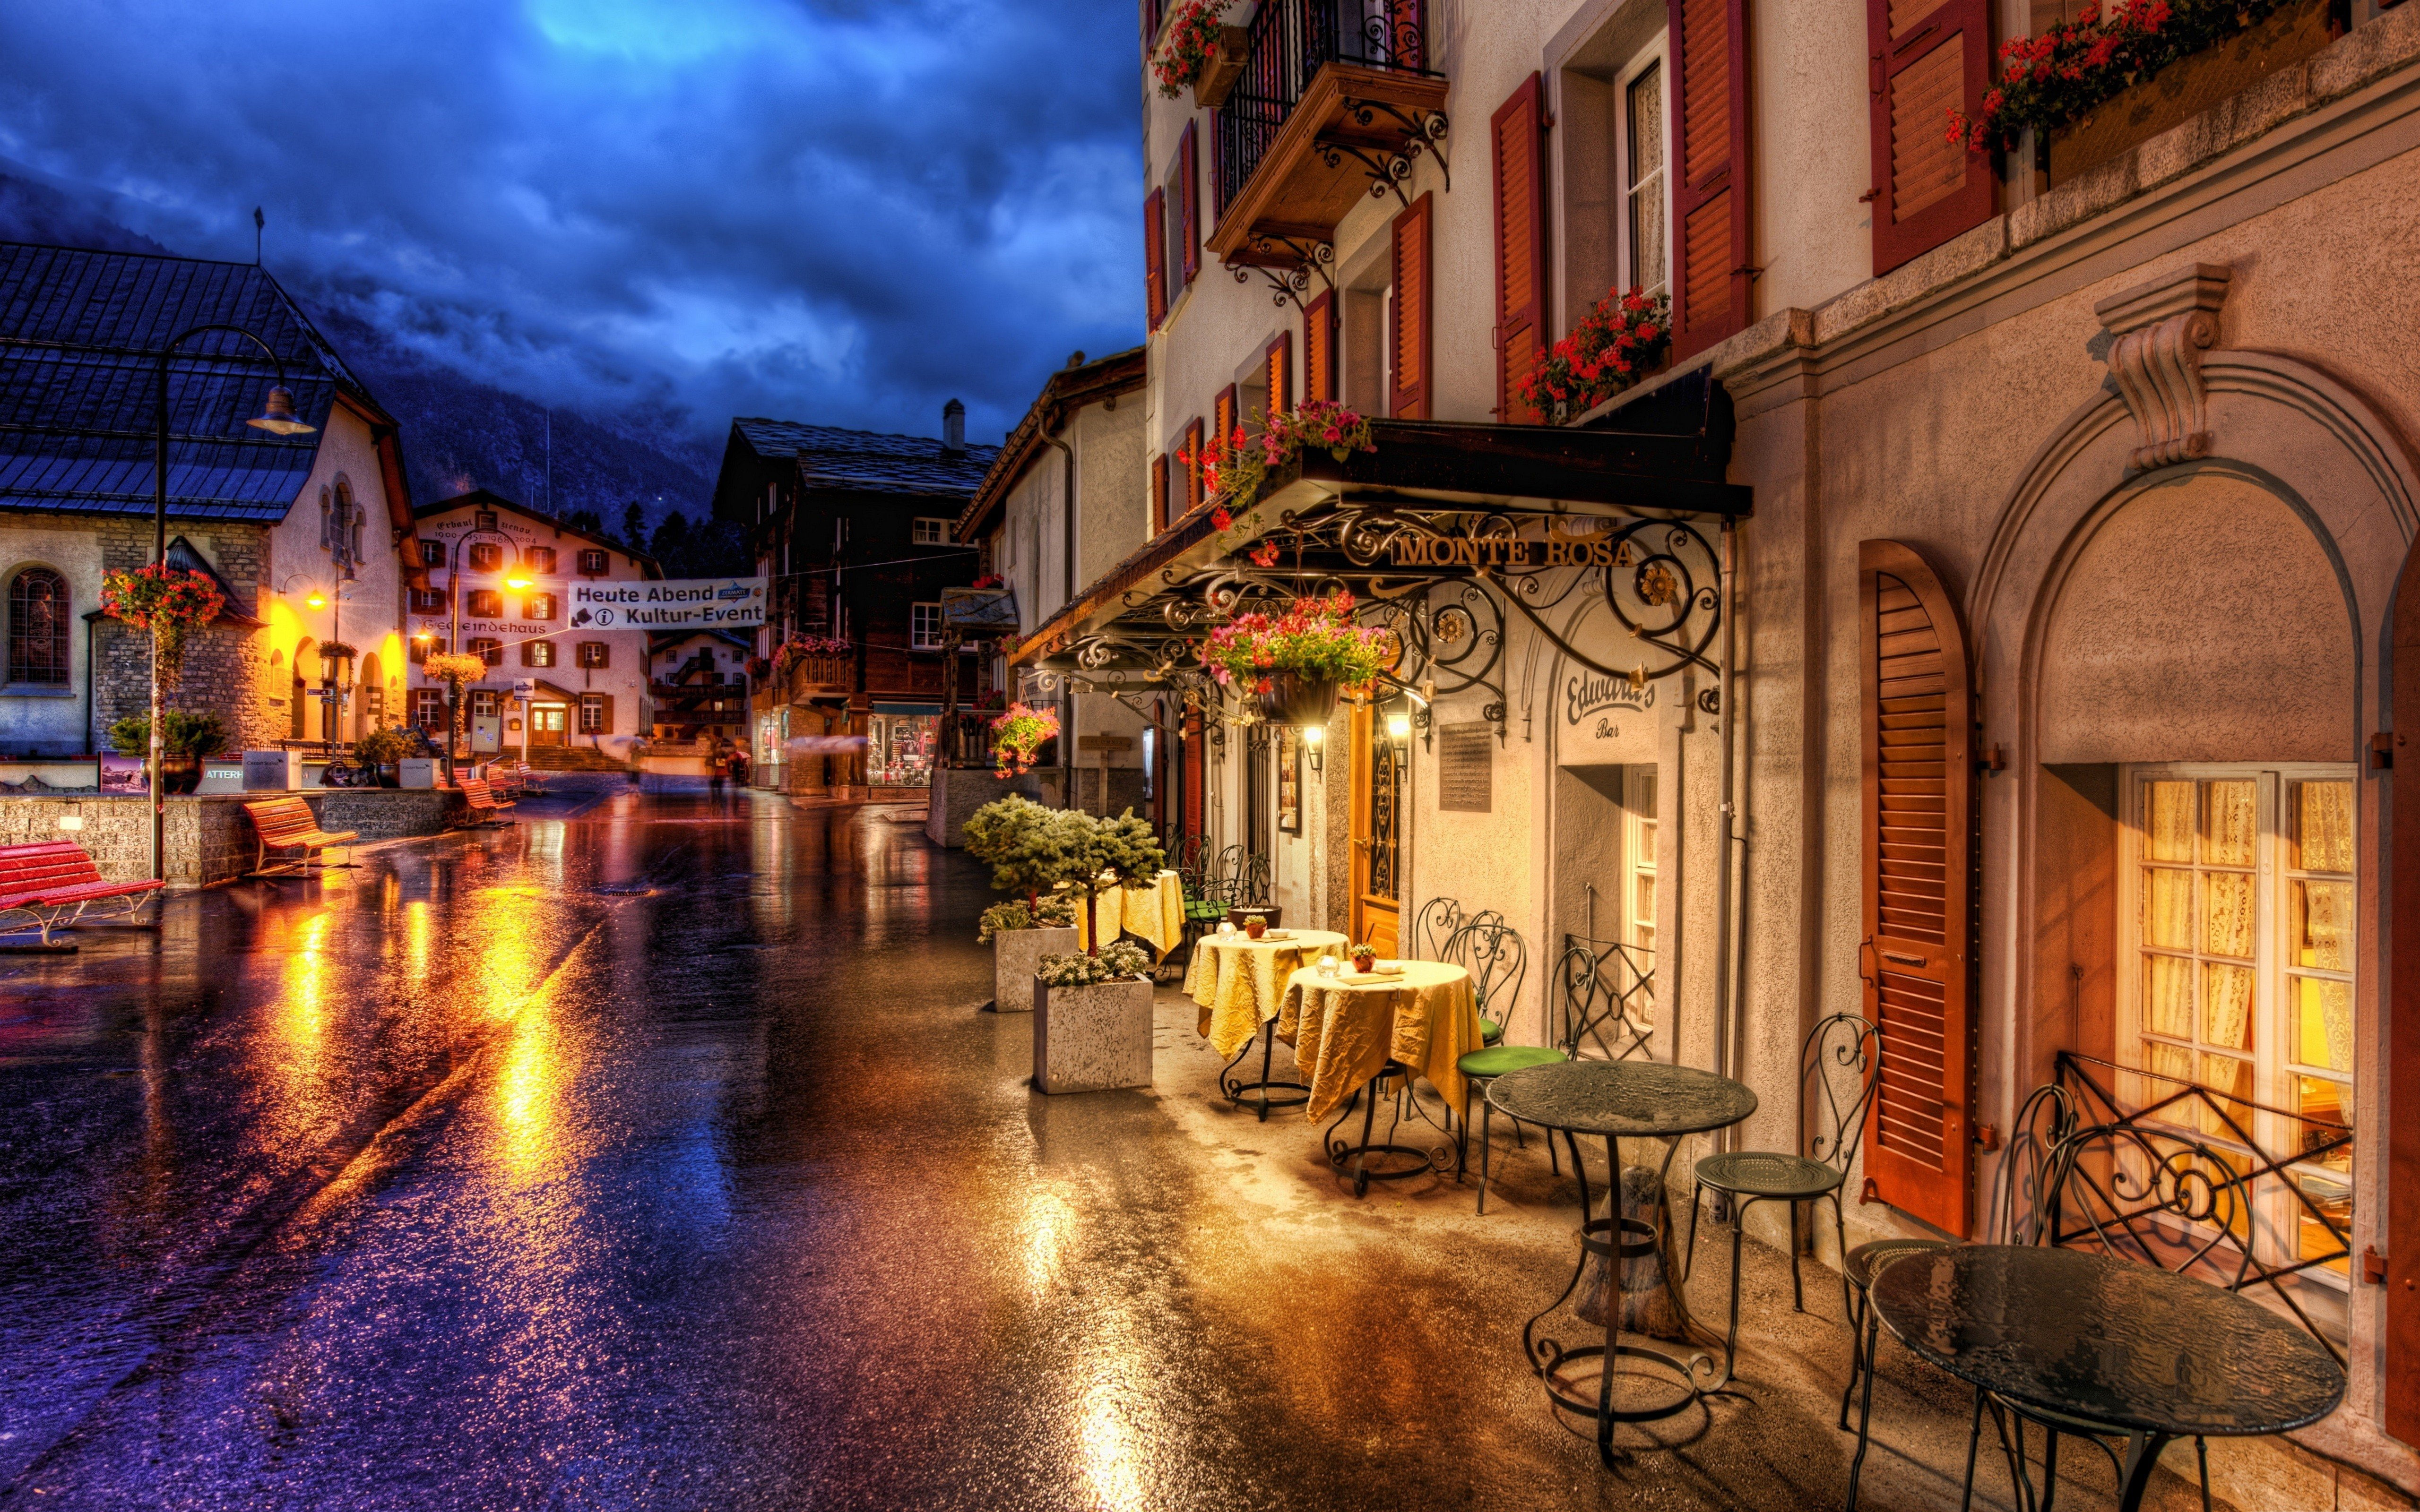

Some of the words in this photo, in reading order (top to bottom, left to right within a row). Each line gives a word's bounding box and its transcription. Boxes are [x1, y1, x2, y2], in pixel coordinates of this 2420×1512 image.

[1396, 537, 1529, 566] MONTE
[1544, 540, 1636, 567] ROSA
[577, 587, 639, 602] Heute
[647, 585, 713, 602] Abend
[626, 606, 762, 623] Kultur-Event
[1596, 718, 1619, 739] Bar
[204, 770, 243, 779] ATTERH
